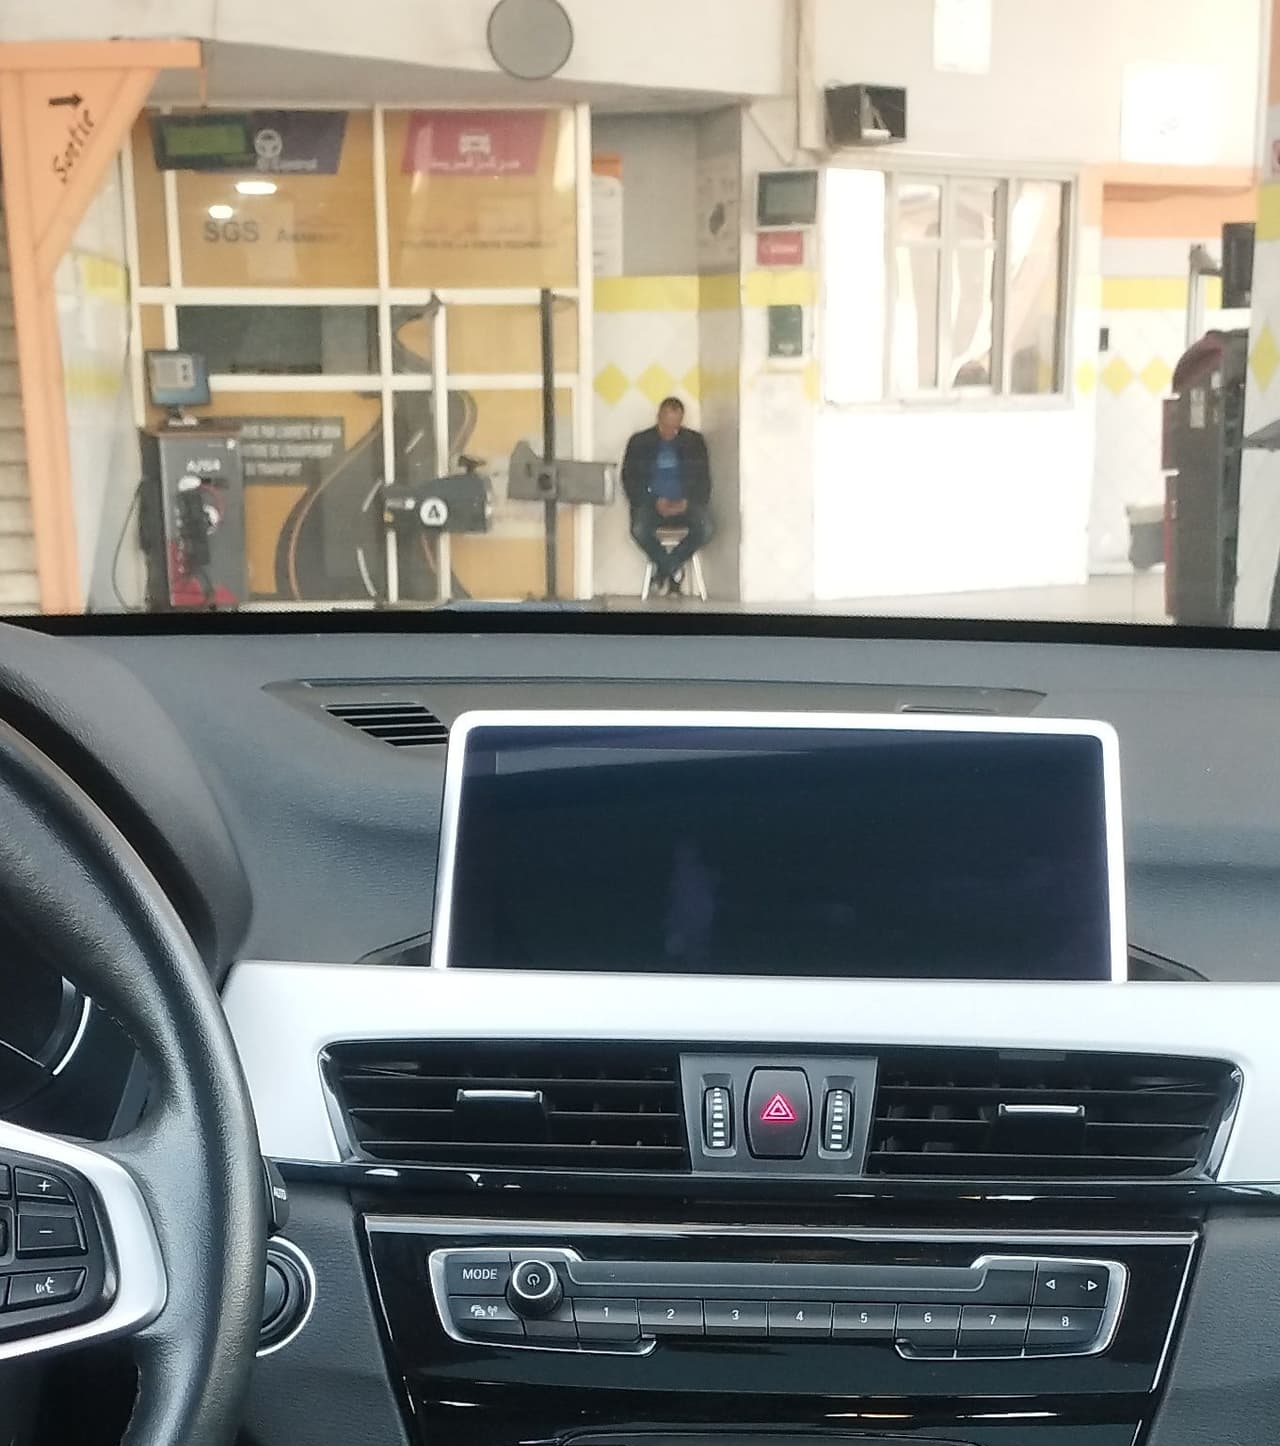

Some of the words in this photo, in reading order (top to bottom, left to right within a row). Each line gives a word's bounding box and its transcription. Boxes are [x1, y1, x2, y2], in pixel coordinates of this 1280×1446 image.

[203, 220, 260, 243] SGS
[462, 1268, 498, 1280] MODE
[667, 1308, 675, 1319] 2
[731, 1309, 740, 1320] 3
[795, 1311, 804, 1321] 4
[860, 1313, 868, 1324] 5
[923, 1313, 932, 1323] 6
[988, 1314, 997, 1325] 7
[1061, 1315, 1070, 1327] 8
